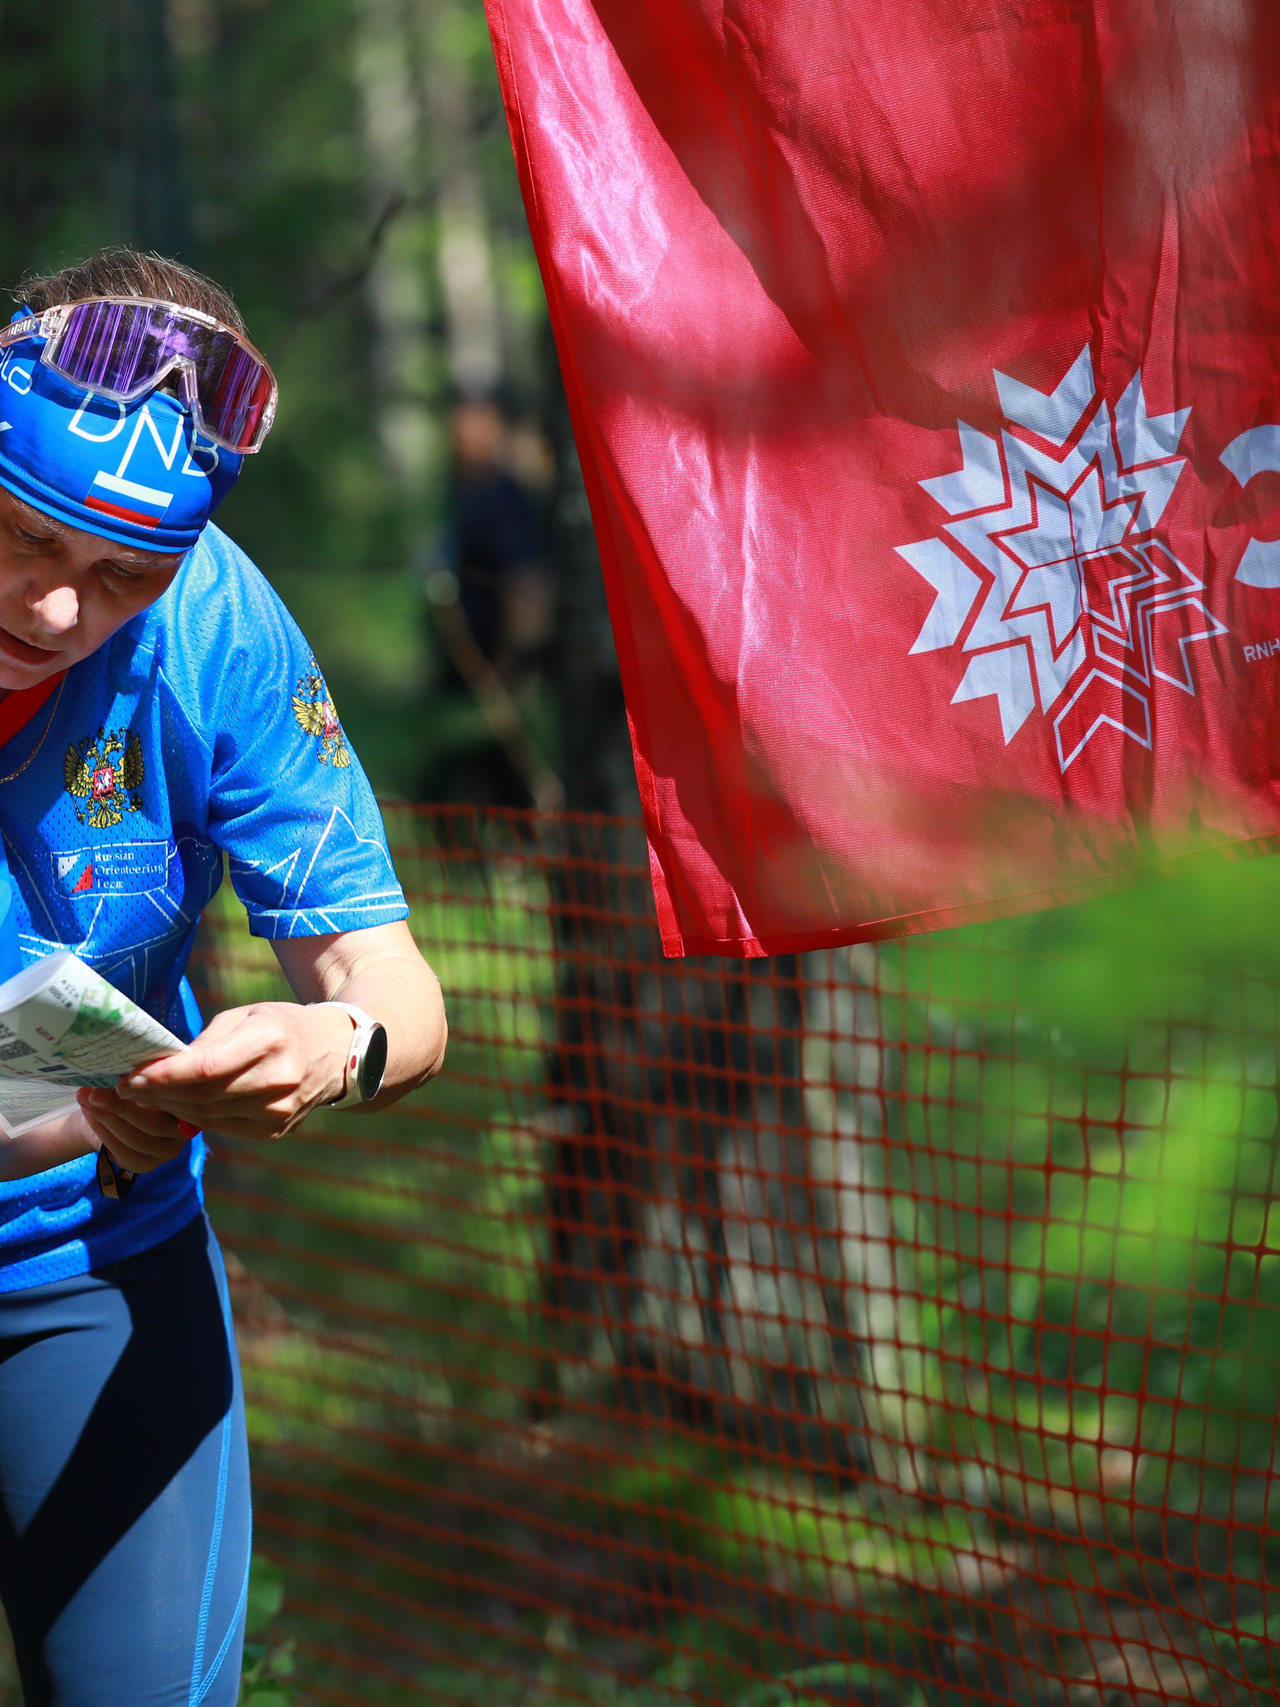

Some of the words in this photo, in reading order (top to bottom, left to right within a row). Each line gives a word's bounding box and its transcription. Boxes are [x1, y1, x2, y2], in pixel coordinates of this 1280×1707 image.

[94, 850, 135, 862] Russian
[94, 863, 164, 876] Orienteering
[94, 878, 124, 889] Team
